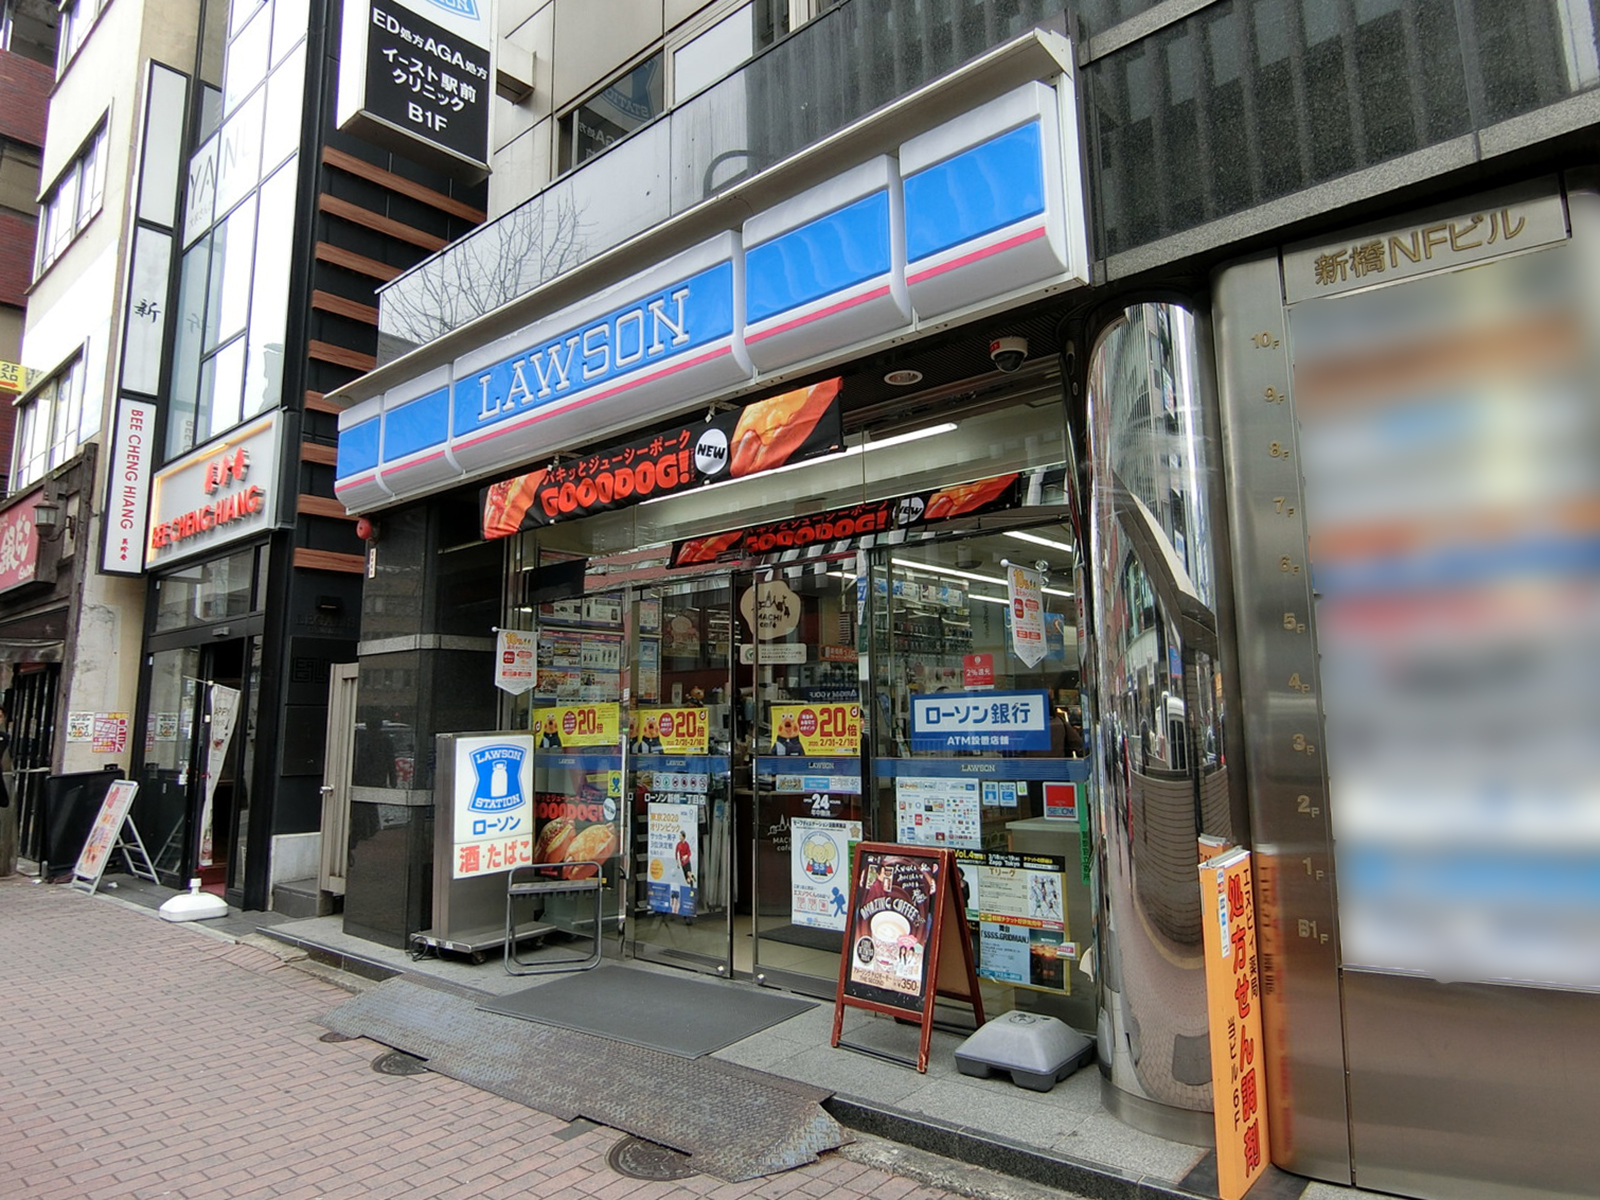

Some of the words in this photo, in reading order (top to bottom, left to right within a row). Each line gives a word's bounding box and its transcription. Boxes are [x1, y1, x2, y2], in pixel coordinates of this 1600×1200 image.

[392, 68, 465, 112] クリニック
[408, 101, 448, 131] B1F
[1314, 208, 1526, 286] 新橋NFビル
[1251, 330, 1279, 349] 10F
[477, 285, 691, 422] LAWSON
[1, 371, 18, 382] 入口
[2, 363, 19, 374] 2F
[1264, 385, 1284, 404] 9F
[130, 409, 144, 431] BEE
[125, 434, 142, 482] CHENG
[541, 430, 692, 486] パキッとジューシーポーク
[696, 442, 726, 460] NEW
[1268, 441, 1289, 461] 8F
[541, 447, 691, 517] GOOODOG!
[120, 485, 137, 530] HIANG
[152, 522, 169, 548] BEE
[170, 504, 212, 541] CHENG
[213, 485, 261, 526] HIANG
[1273, 497, 1294, 517] 7F
[1279, 555, 1299, 575] 6F
[1283, 613, 1305, 634] 5F
[1288, 673, 1310, 695] 4F
[925, 702, 1030, 725] ローソン銀行
[115, 718, 128, 752] OPEN
[947, 735, 1009, 746] ATM設置店舗
[1292, 733, 1315, 755] 3F
[476, 750, 523, 763] LAWSON
[961, 763, 996, 773] LAWSON
[474, 793, 521, 809] STATION
[812, 793, 830, 809] 24
[1047, 807, 1074, 816] SECOM
[1297, 795, 1319, 817] 2F
[472, 816, 521, 835] ローソン
[1302, 857, 1324, 880] 1F
[1298, 919, 1328, 944] B1F
